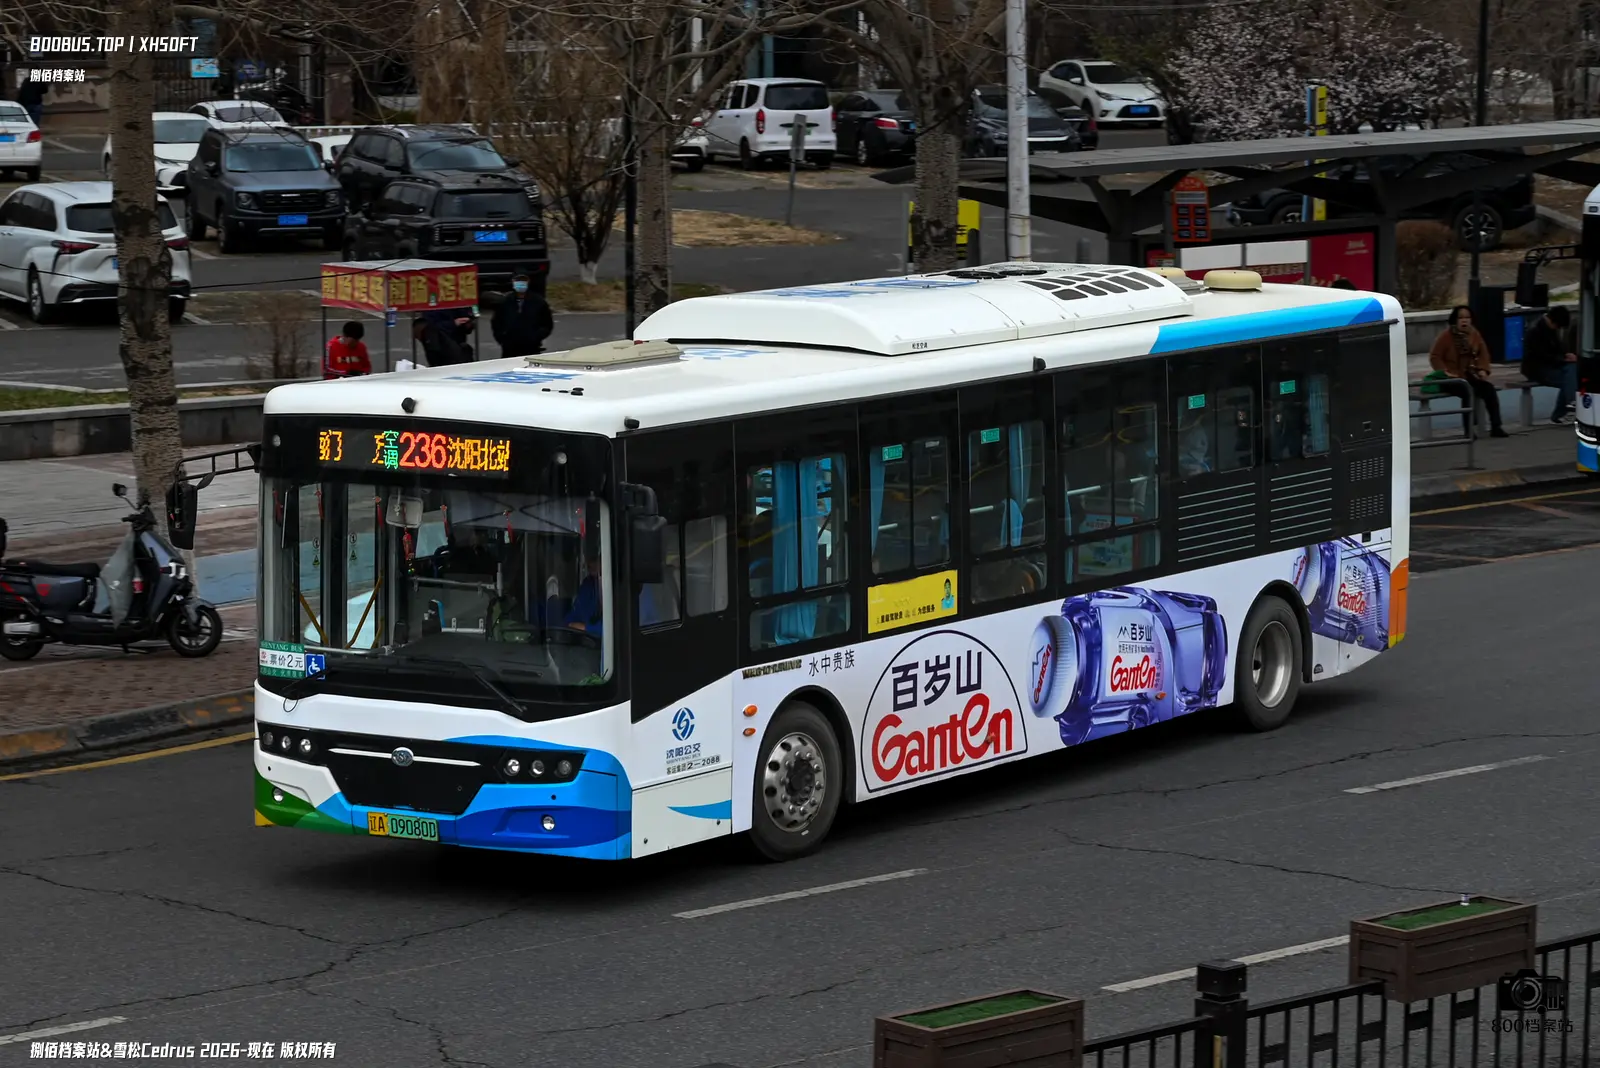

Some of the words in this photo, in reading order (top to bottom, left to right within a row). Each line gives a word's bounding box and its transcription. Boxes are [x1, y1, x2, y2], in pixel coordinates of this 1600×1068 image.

[384, 430, 399, 470] 空调
[400, 431, 447, 469] 236
[447, 436, 511, 472] 沈阳北站
[1130, 622, 1153, 642] 百岁山
[270, 653, 304, 668] 票价2元
[808, 648, 855, 677] 水中贵族
[1110, 655, 1157, 692] Ganten
[891, 649, 983, 712] 百岁山
[666, 742, 701, 760] 沈阳公交
[871, 692, 1013, 782] Ganten
